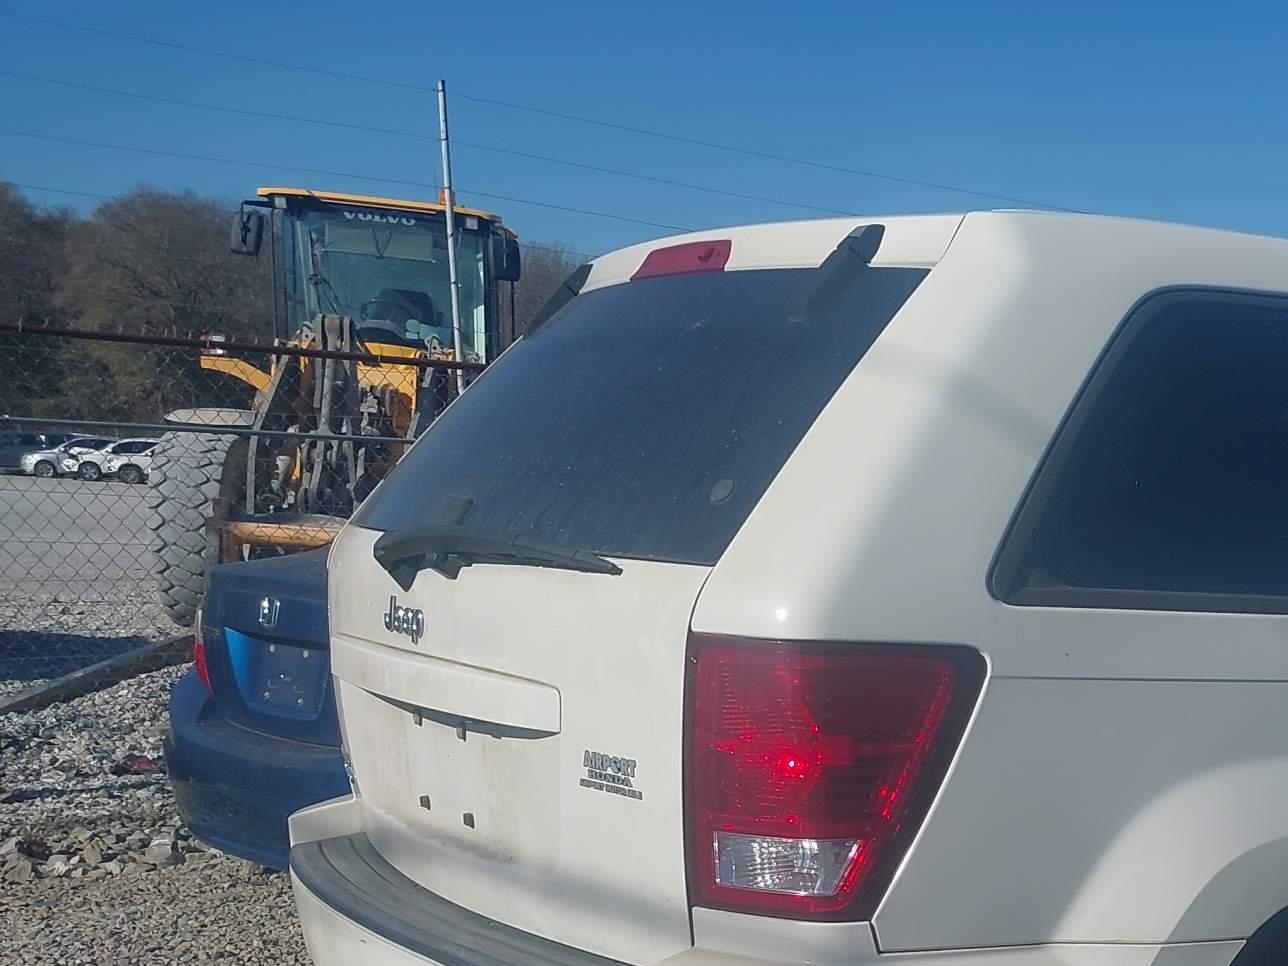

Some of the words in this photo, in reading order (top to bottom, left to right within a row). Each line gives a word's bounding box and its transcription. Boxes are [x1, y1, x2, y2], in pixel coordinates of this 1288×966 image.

[383, 595, 425, 645] Jeep
[583, 749, 637, 778] AIRPORT
[587, 768, 633, 788] HONDA
